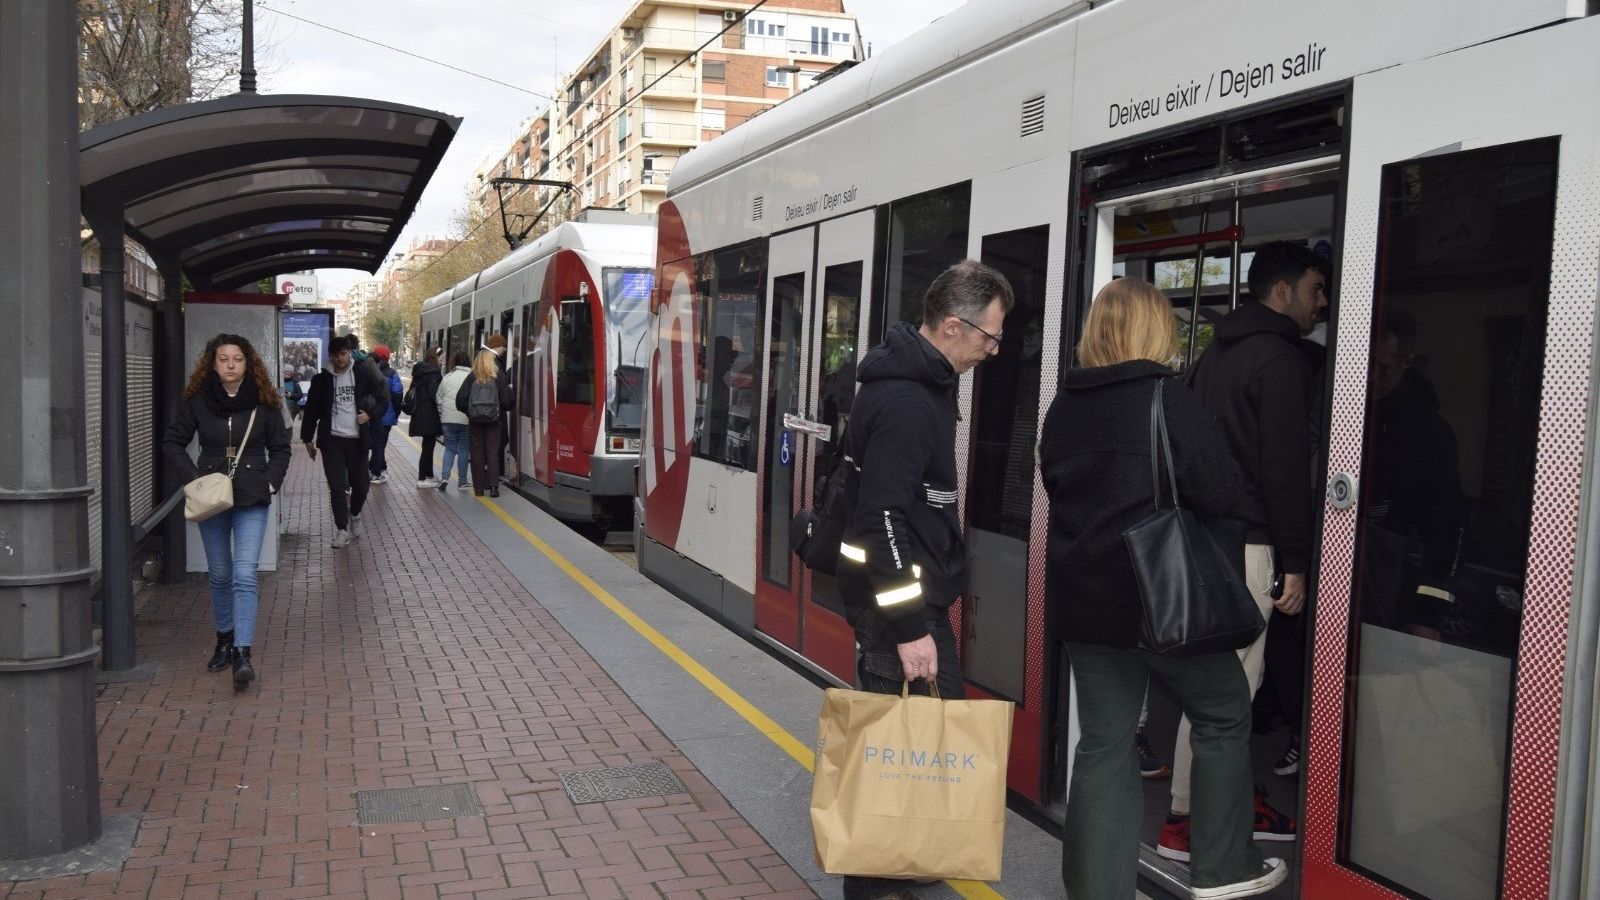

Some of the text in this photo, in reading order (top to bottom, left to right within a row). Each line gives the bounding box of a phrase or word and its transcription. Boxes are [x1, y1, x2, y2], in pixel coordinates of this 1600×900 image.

[1109, 43, 1327, 128] Deixeu eixir / Dejen salir
[786, 204, 805, 221] Deixeu
[823, 192, 842, 211] Dejen
[843, 184, 858, 204] salir
[865, 746, 976, 770] PRIMARK
[879, 772, 961, 783] LOVE THE FEELING
